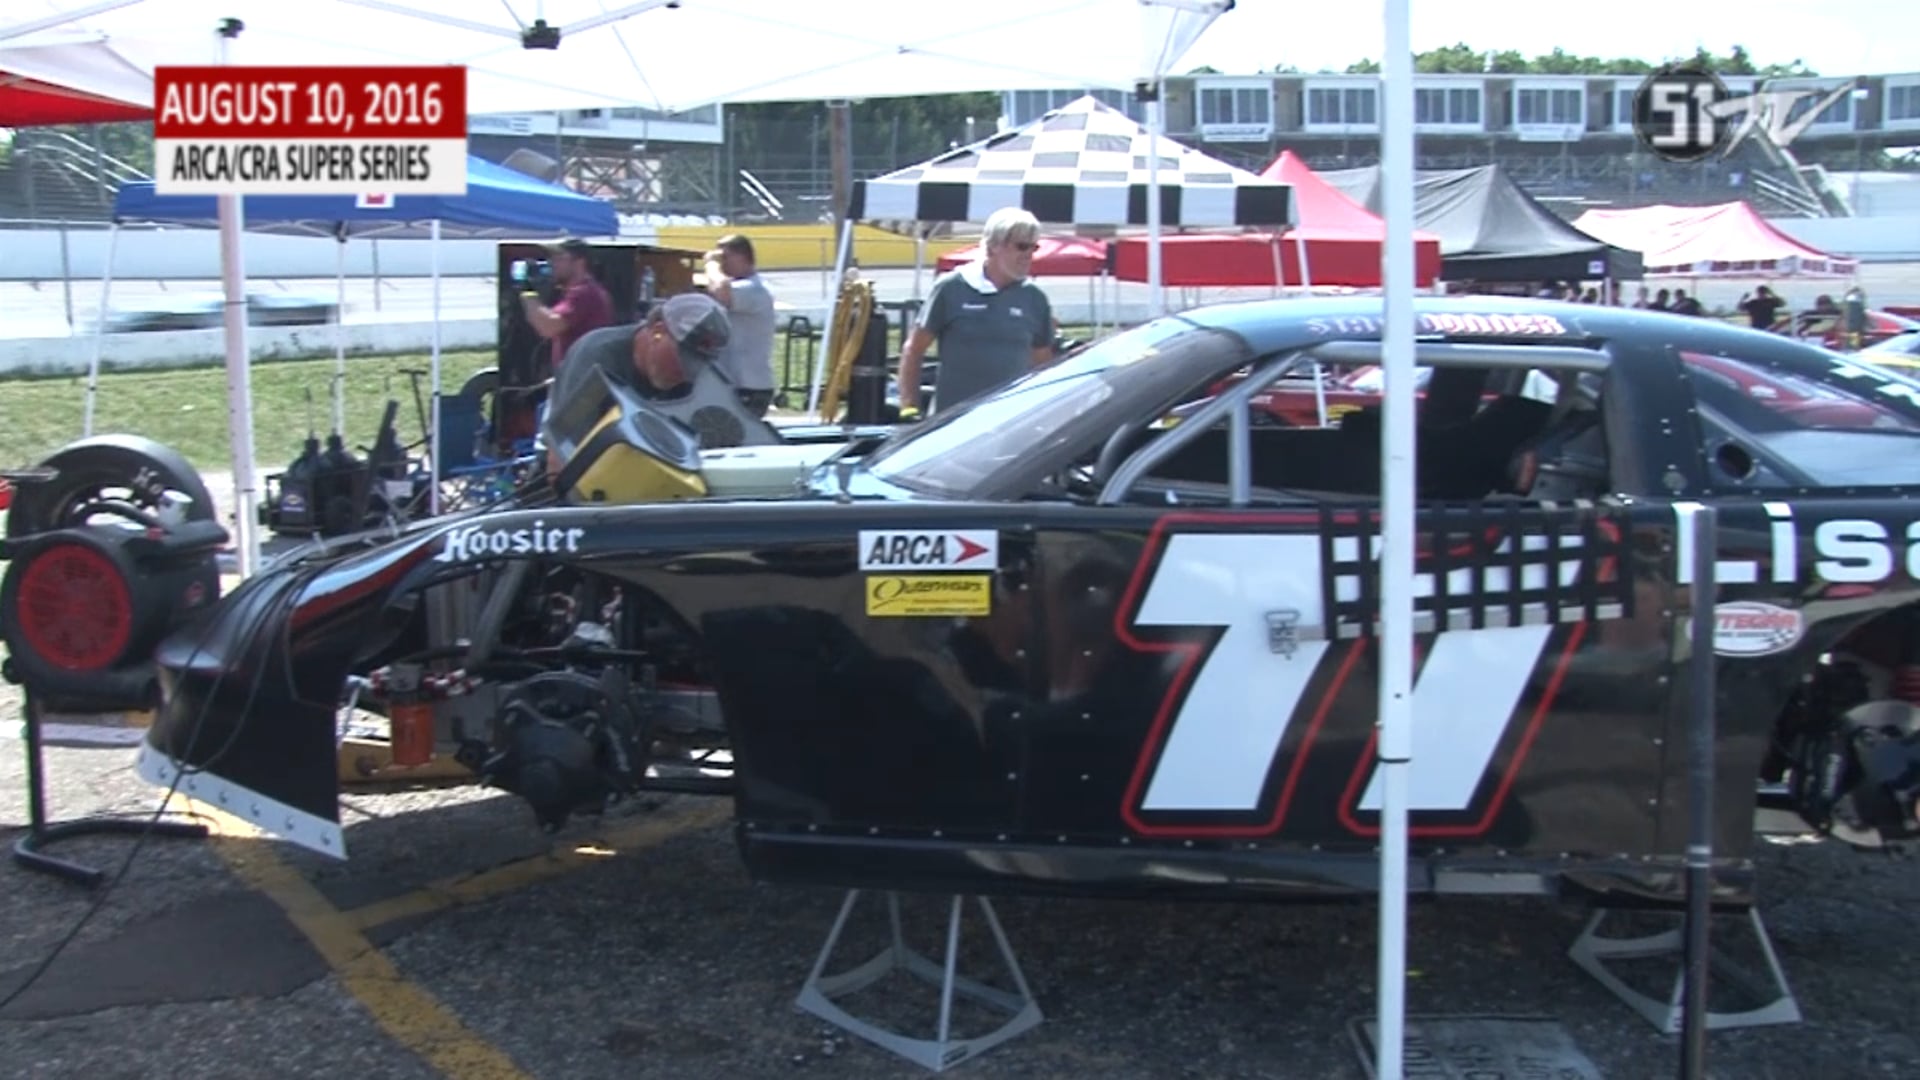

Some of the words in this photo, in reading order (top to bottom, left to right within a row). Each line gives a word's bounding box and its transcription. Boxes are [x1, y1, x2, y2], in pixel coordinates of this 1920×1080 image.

[433, 519, 585, 562] Hoosier
[866, 534, 947, 565] ARCA
[1671, 501, 1920, 584] Lis
